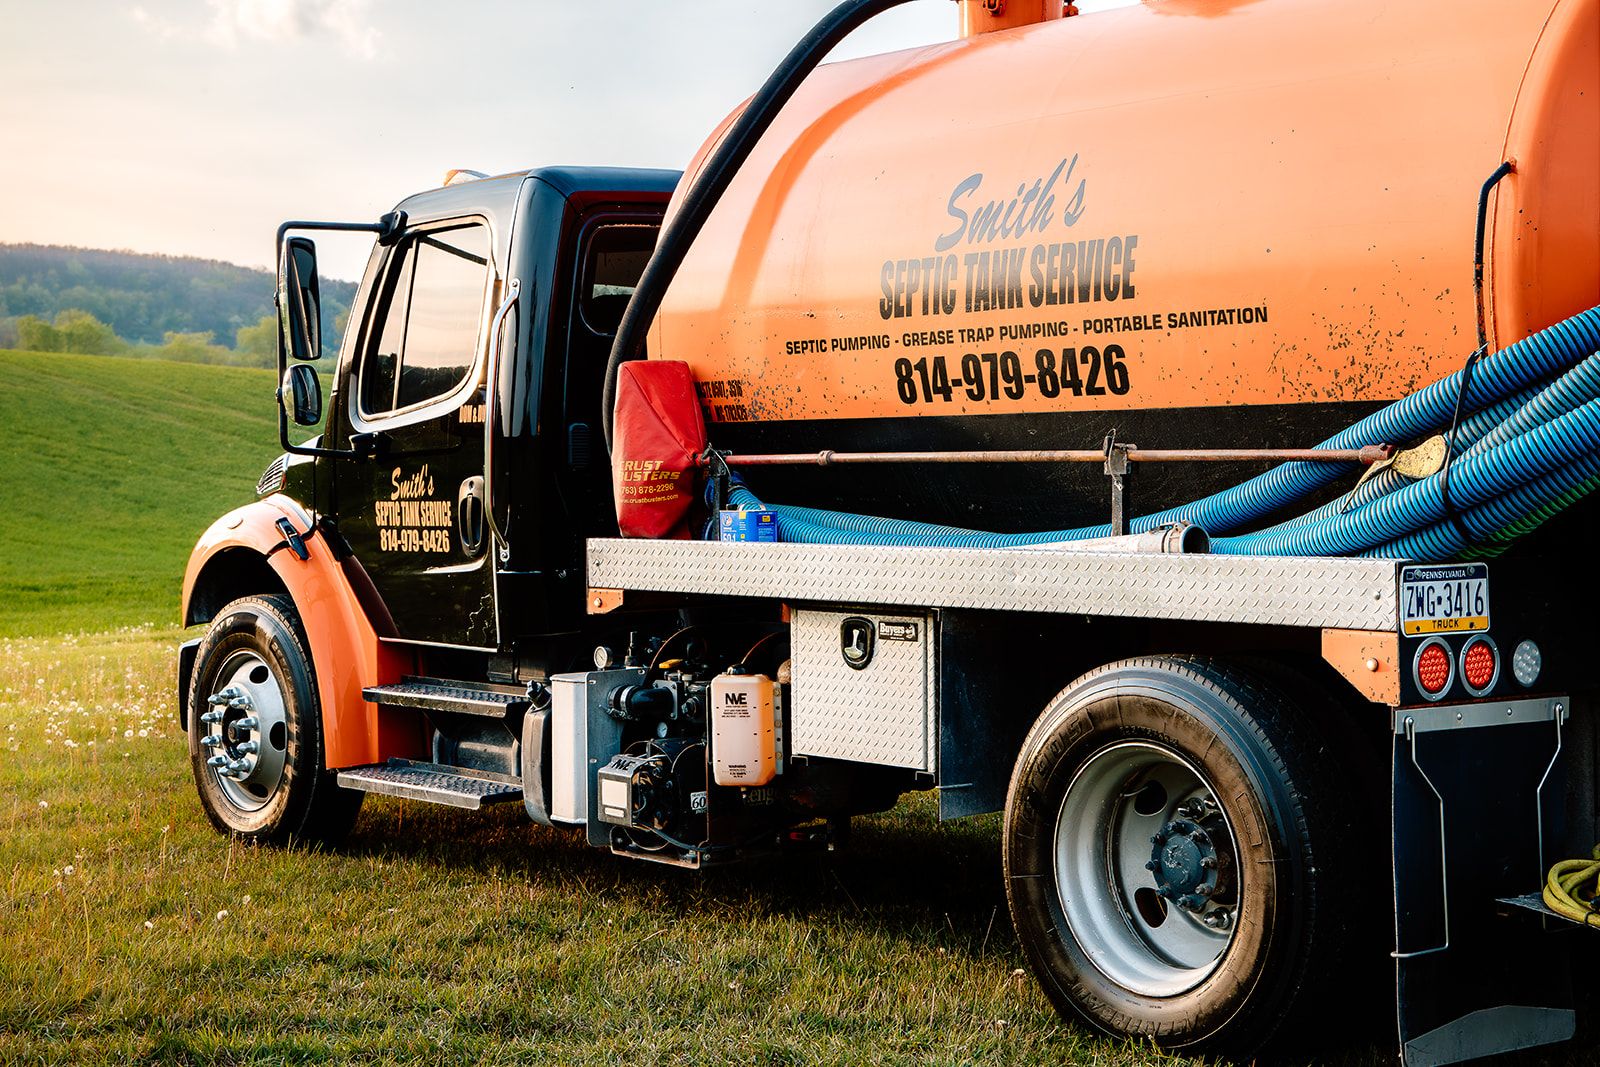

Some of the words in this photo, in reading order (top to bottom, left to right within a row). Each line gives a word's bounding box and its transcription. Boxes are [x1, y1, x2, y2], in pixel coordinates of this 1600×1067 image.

[934, 153, 1087, 252] Smith's
[879, 255, 958, 320] SEPTIC
[964, 244, 1026, 313] TANK
[1029, 235, 1139, 308] SERVICE
[786, 338, 827, 355] SEPTIC
[831, 334, 890, 353] PUMPING
[902, 329, 954, 347] GREASE
[958, 327, 994, 343] TRAP
[999, 322, 1069, 341] PUMPING
[1082, 314, 1163, 335] PORTABLE
[1167, 307, 1268, 329] SANITATION
[894, 344, 1130, 405] 814-979-8426
[391, 464, 434, 500] Smith's
[620, 486, 636, 496] 763)
[638, 483, 674, 495] 878-2296
[375, 501, 400, 526] SEPTIC
[401, 501, 420, 526] TANK
[421, 501, 452, 527] SERVICE
[380, 529, 450, 553] 814-979-8426
[1421, 569, 1466, 579] PENNSYLVANIA
[1432, 620, 1459, 629] TRUCK
[725, 693, 747, 705] NVE
[692, 796, 706, 809] 60
